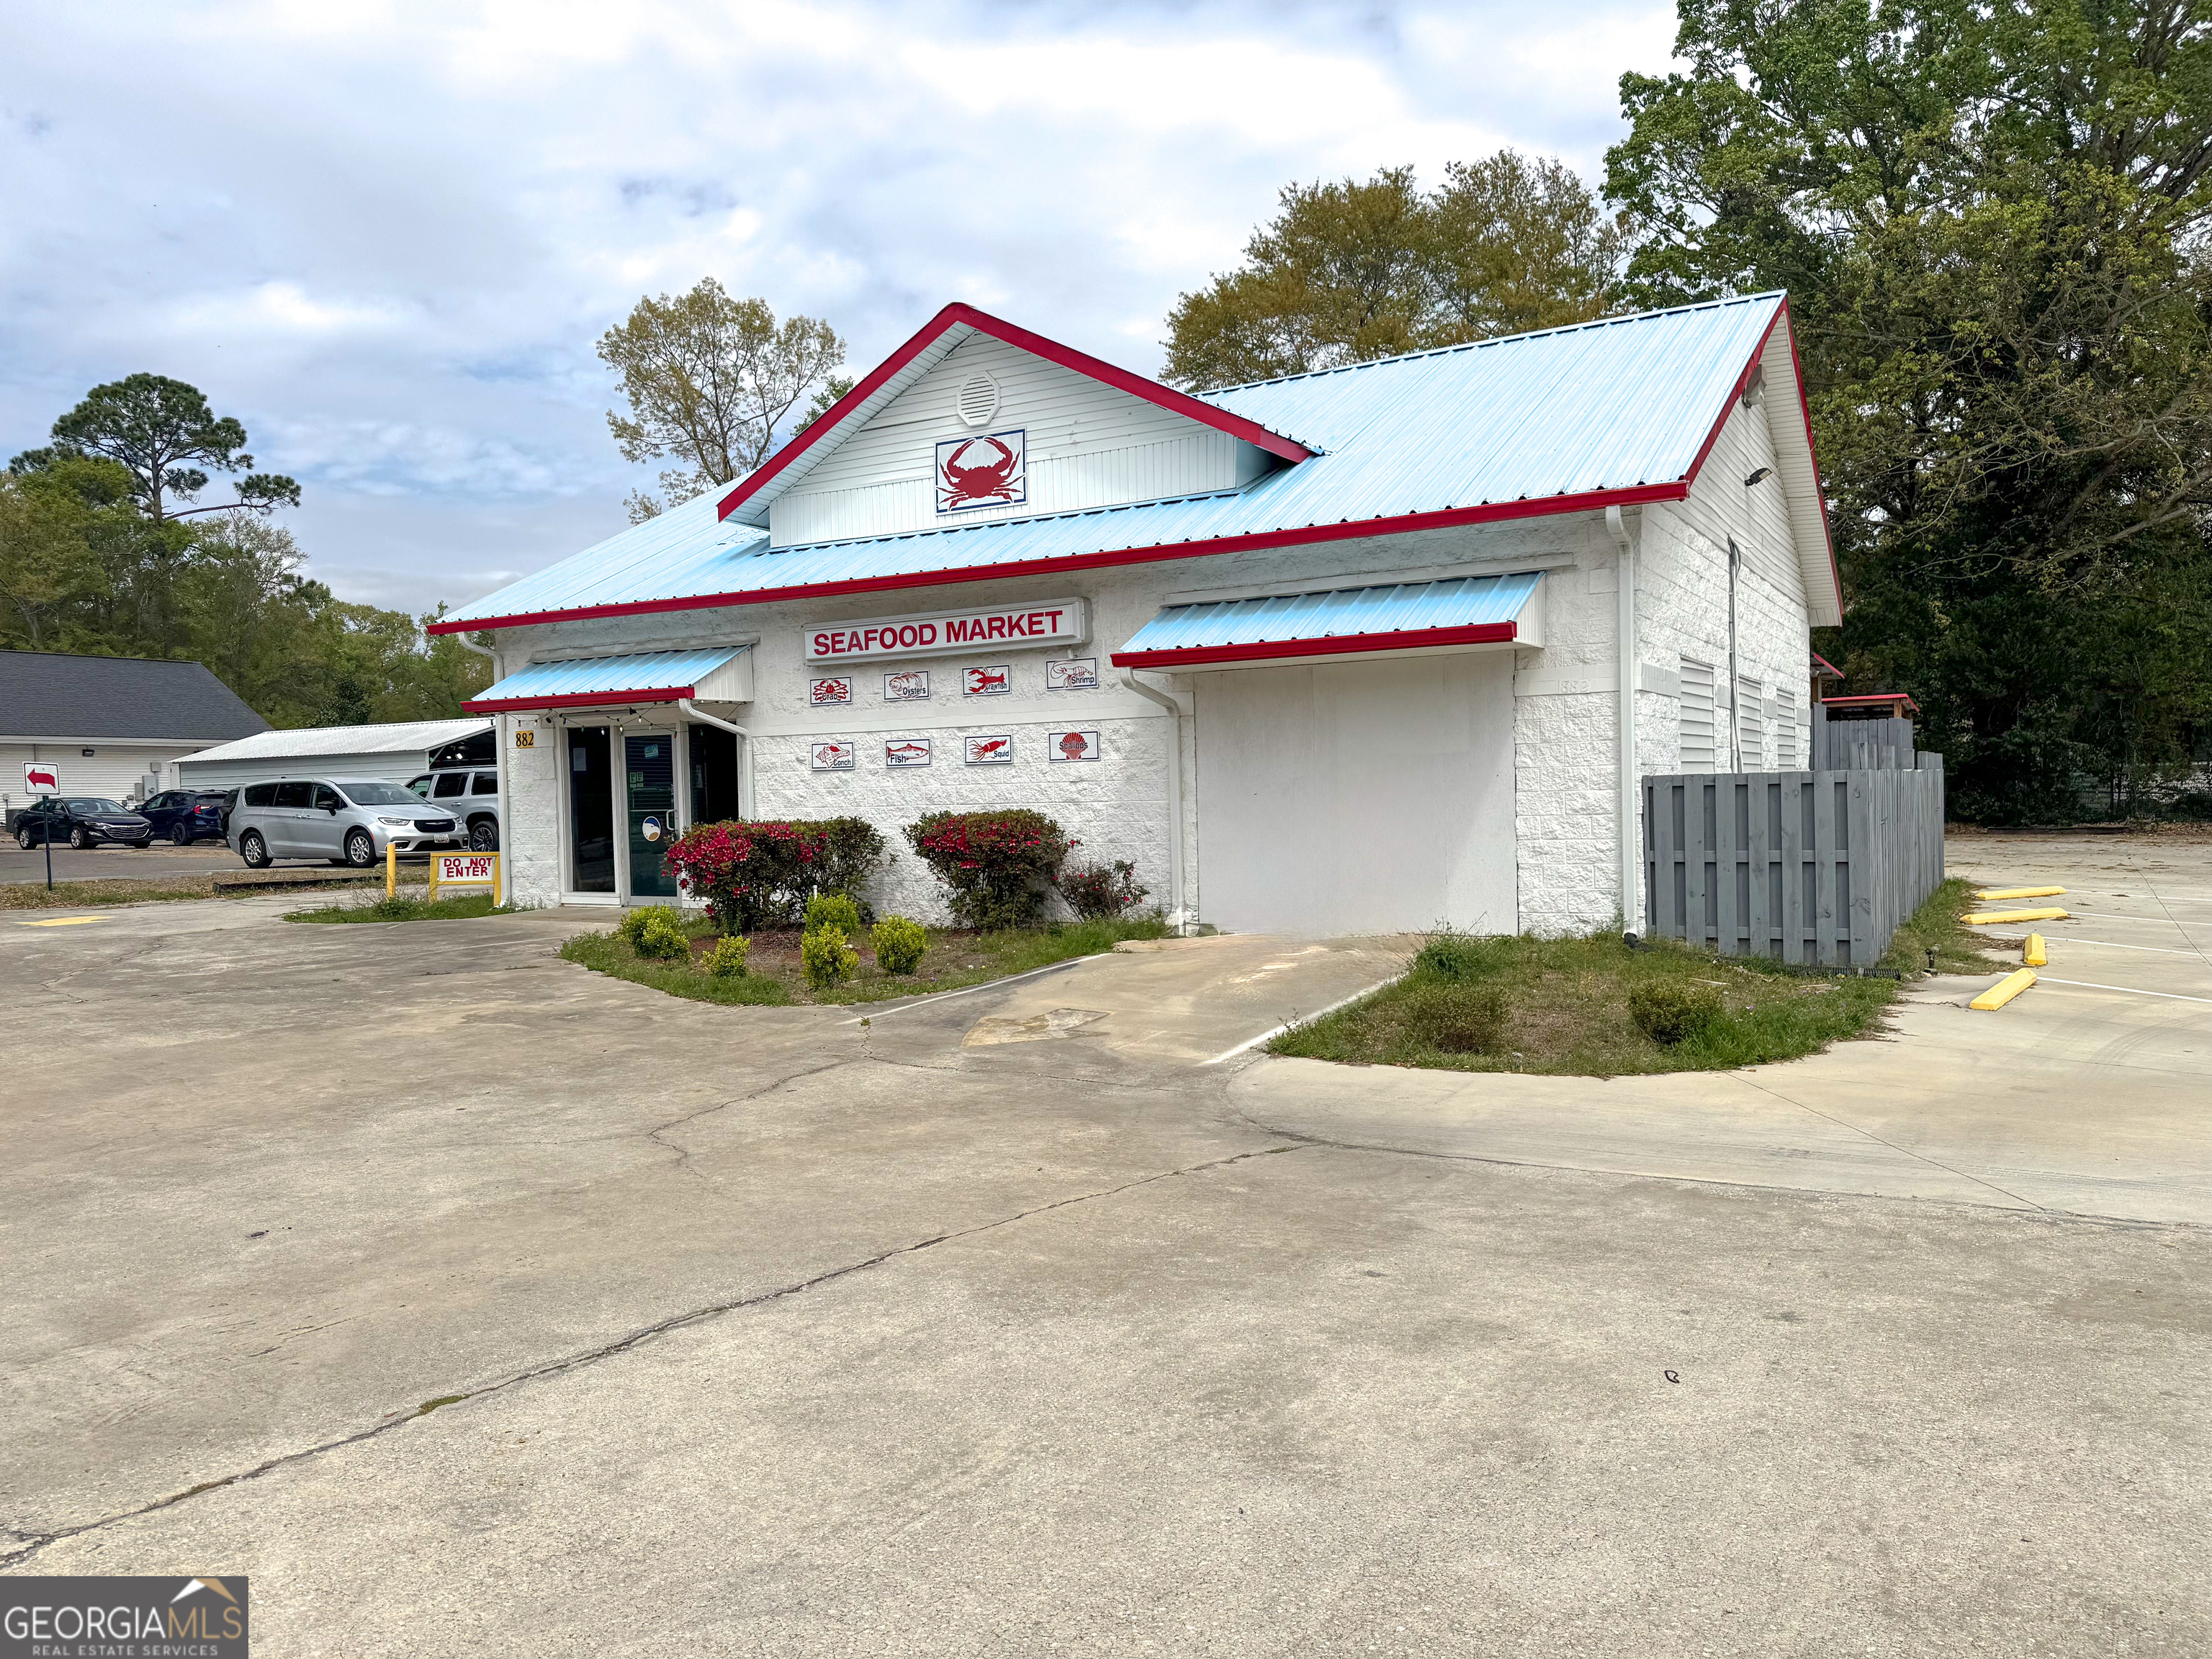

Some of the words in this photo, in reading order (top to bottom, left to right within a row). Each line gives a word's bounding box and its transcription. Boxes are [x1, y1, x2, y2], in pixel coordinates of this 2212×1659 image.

[814, 624, 937, 656] SEAFOOD
[945, 610, 1063, 643] MARKET
[1071, 675, 1094, 685] Shrimp
[902, 686, 926, 696] Oysters
[822, 692, 837, 701] Crab
[516, 732, 534, 747] 882
[1058, 741, 1088, 751] Scallops
[890, 754, 907, 763] Fish
[994, 750, 1009, 758] Squid
[444, 858, 462, 867] DO
[469, 858, 493, 867] NOT
[446, 866, 488, 878] ENTER
